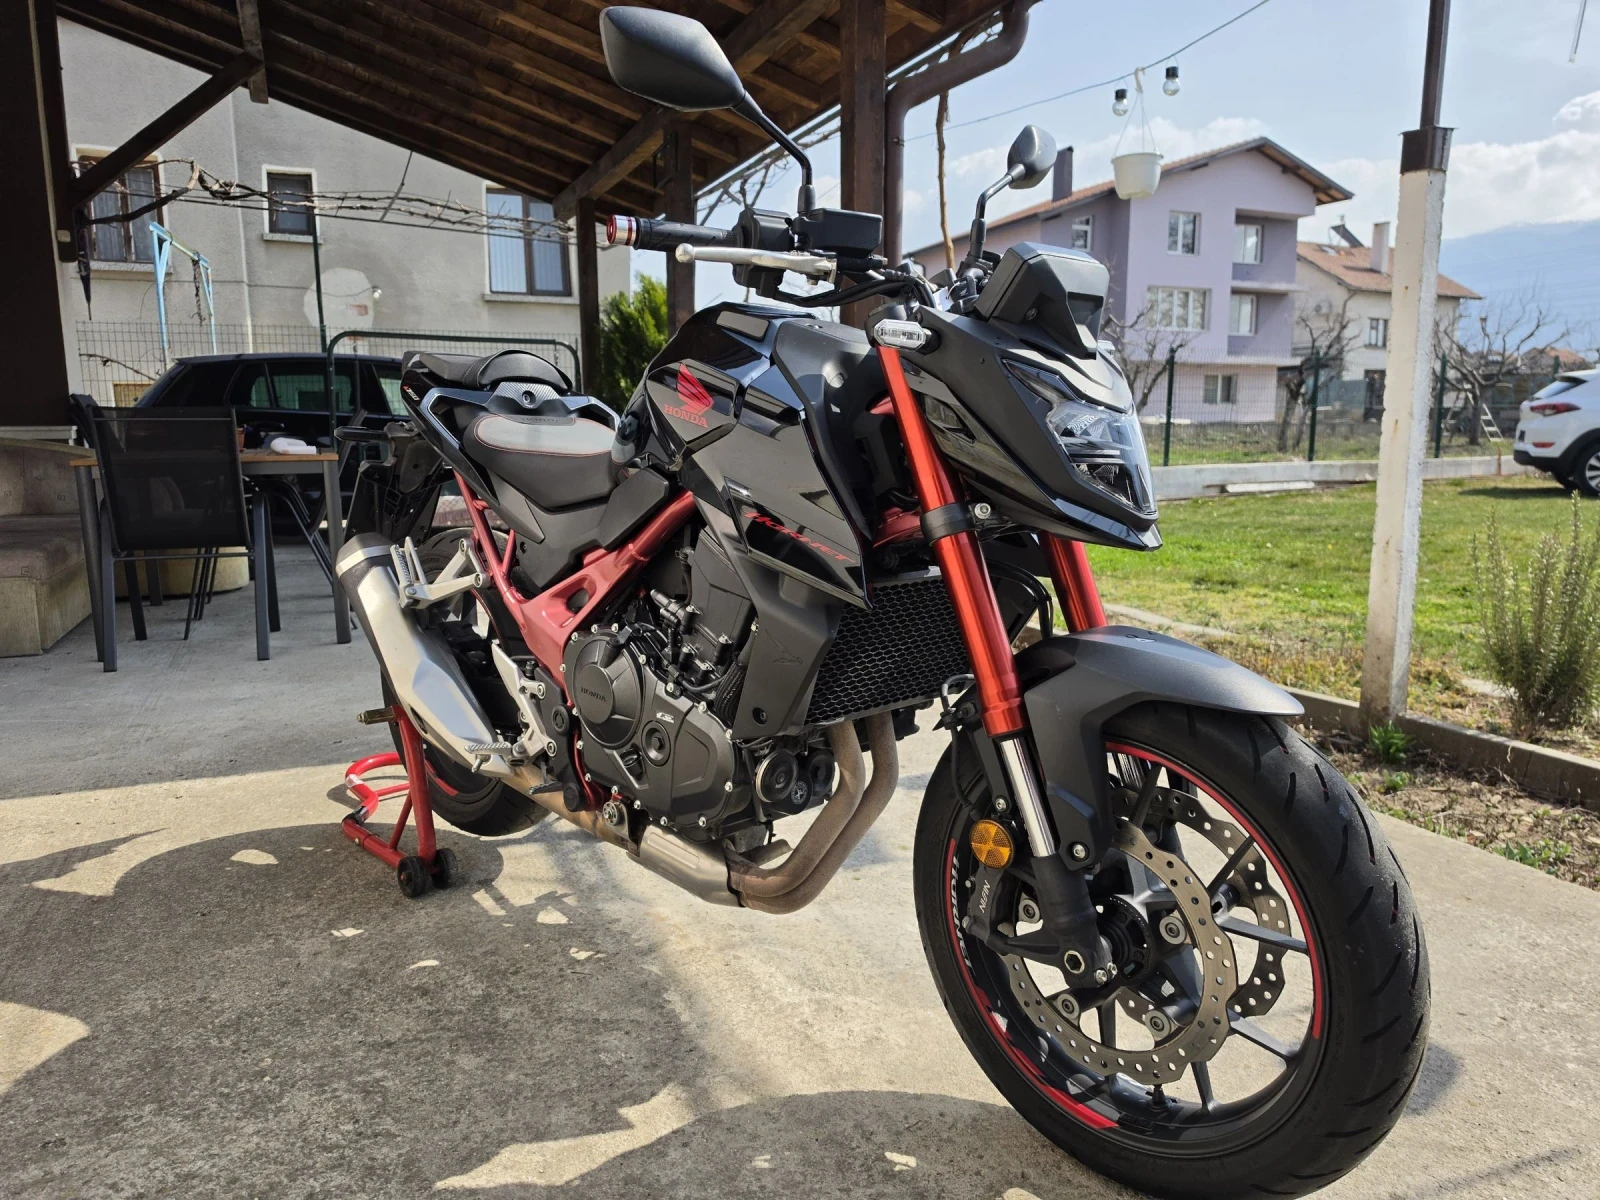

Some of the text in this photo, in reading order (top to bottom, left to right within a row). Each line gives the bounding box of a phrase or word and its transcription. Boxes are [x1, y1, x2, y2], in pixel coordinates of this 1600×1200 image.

[663, 403, 709, 429] HONDA
[744, 511, 857, 563] HORNET
[580, 686, 607, 702] HONDA
[951, 855, 976, 974] HORNET
